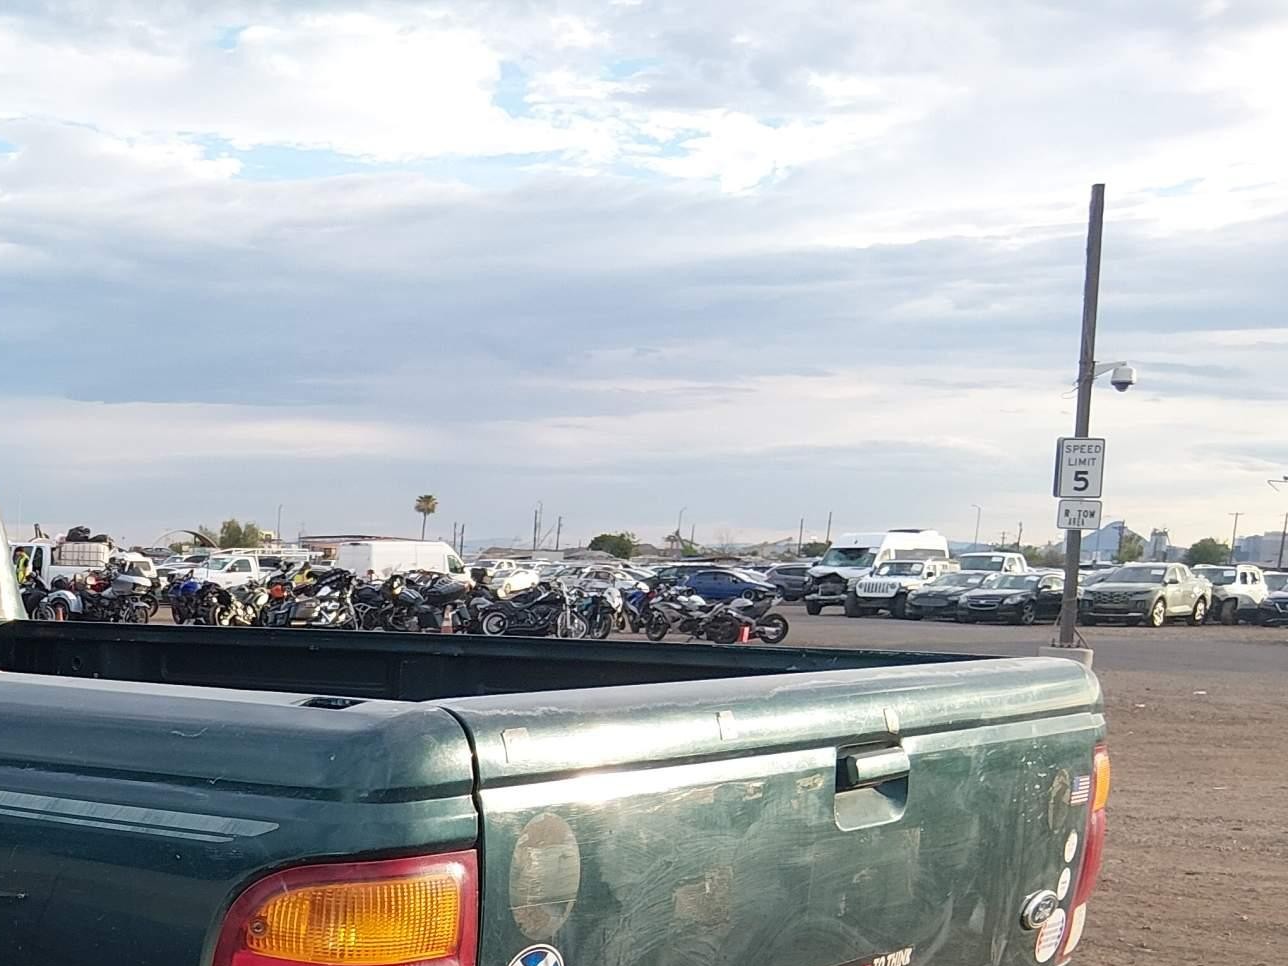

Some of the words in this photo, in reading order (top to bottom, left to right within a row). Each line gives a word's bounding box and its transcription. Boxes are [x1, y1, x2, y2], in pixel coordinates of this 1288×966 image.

[1065, 445, 1102, 454] SPEED
[1068, 458, 1096, 466] LIMIT
[1073, 470, 1089, 491] 5
[1077, 509, 1096, 519] TOW
